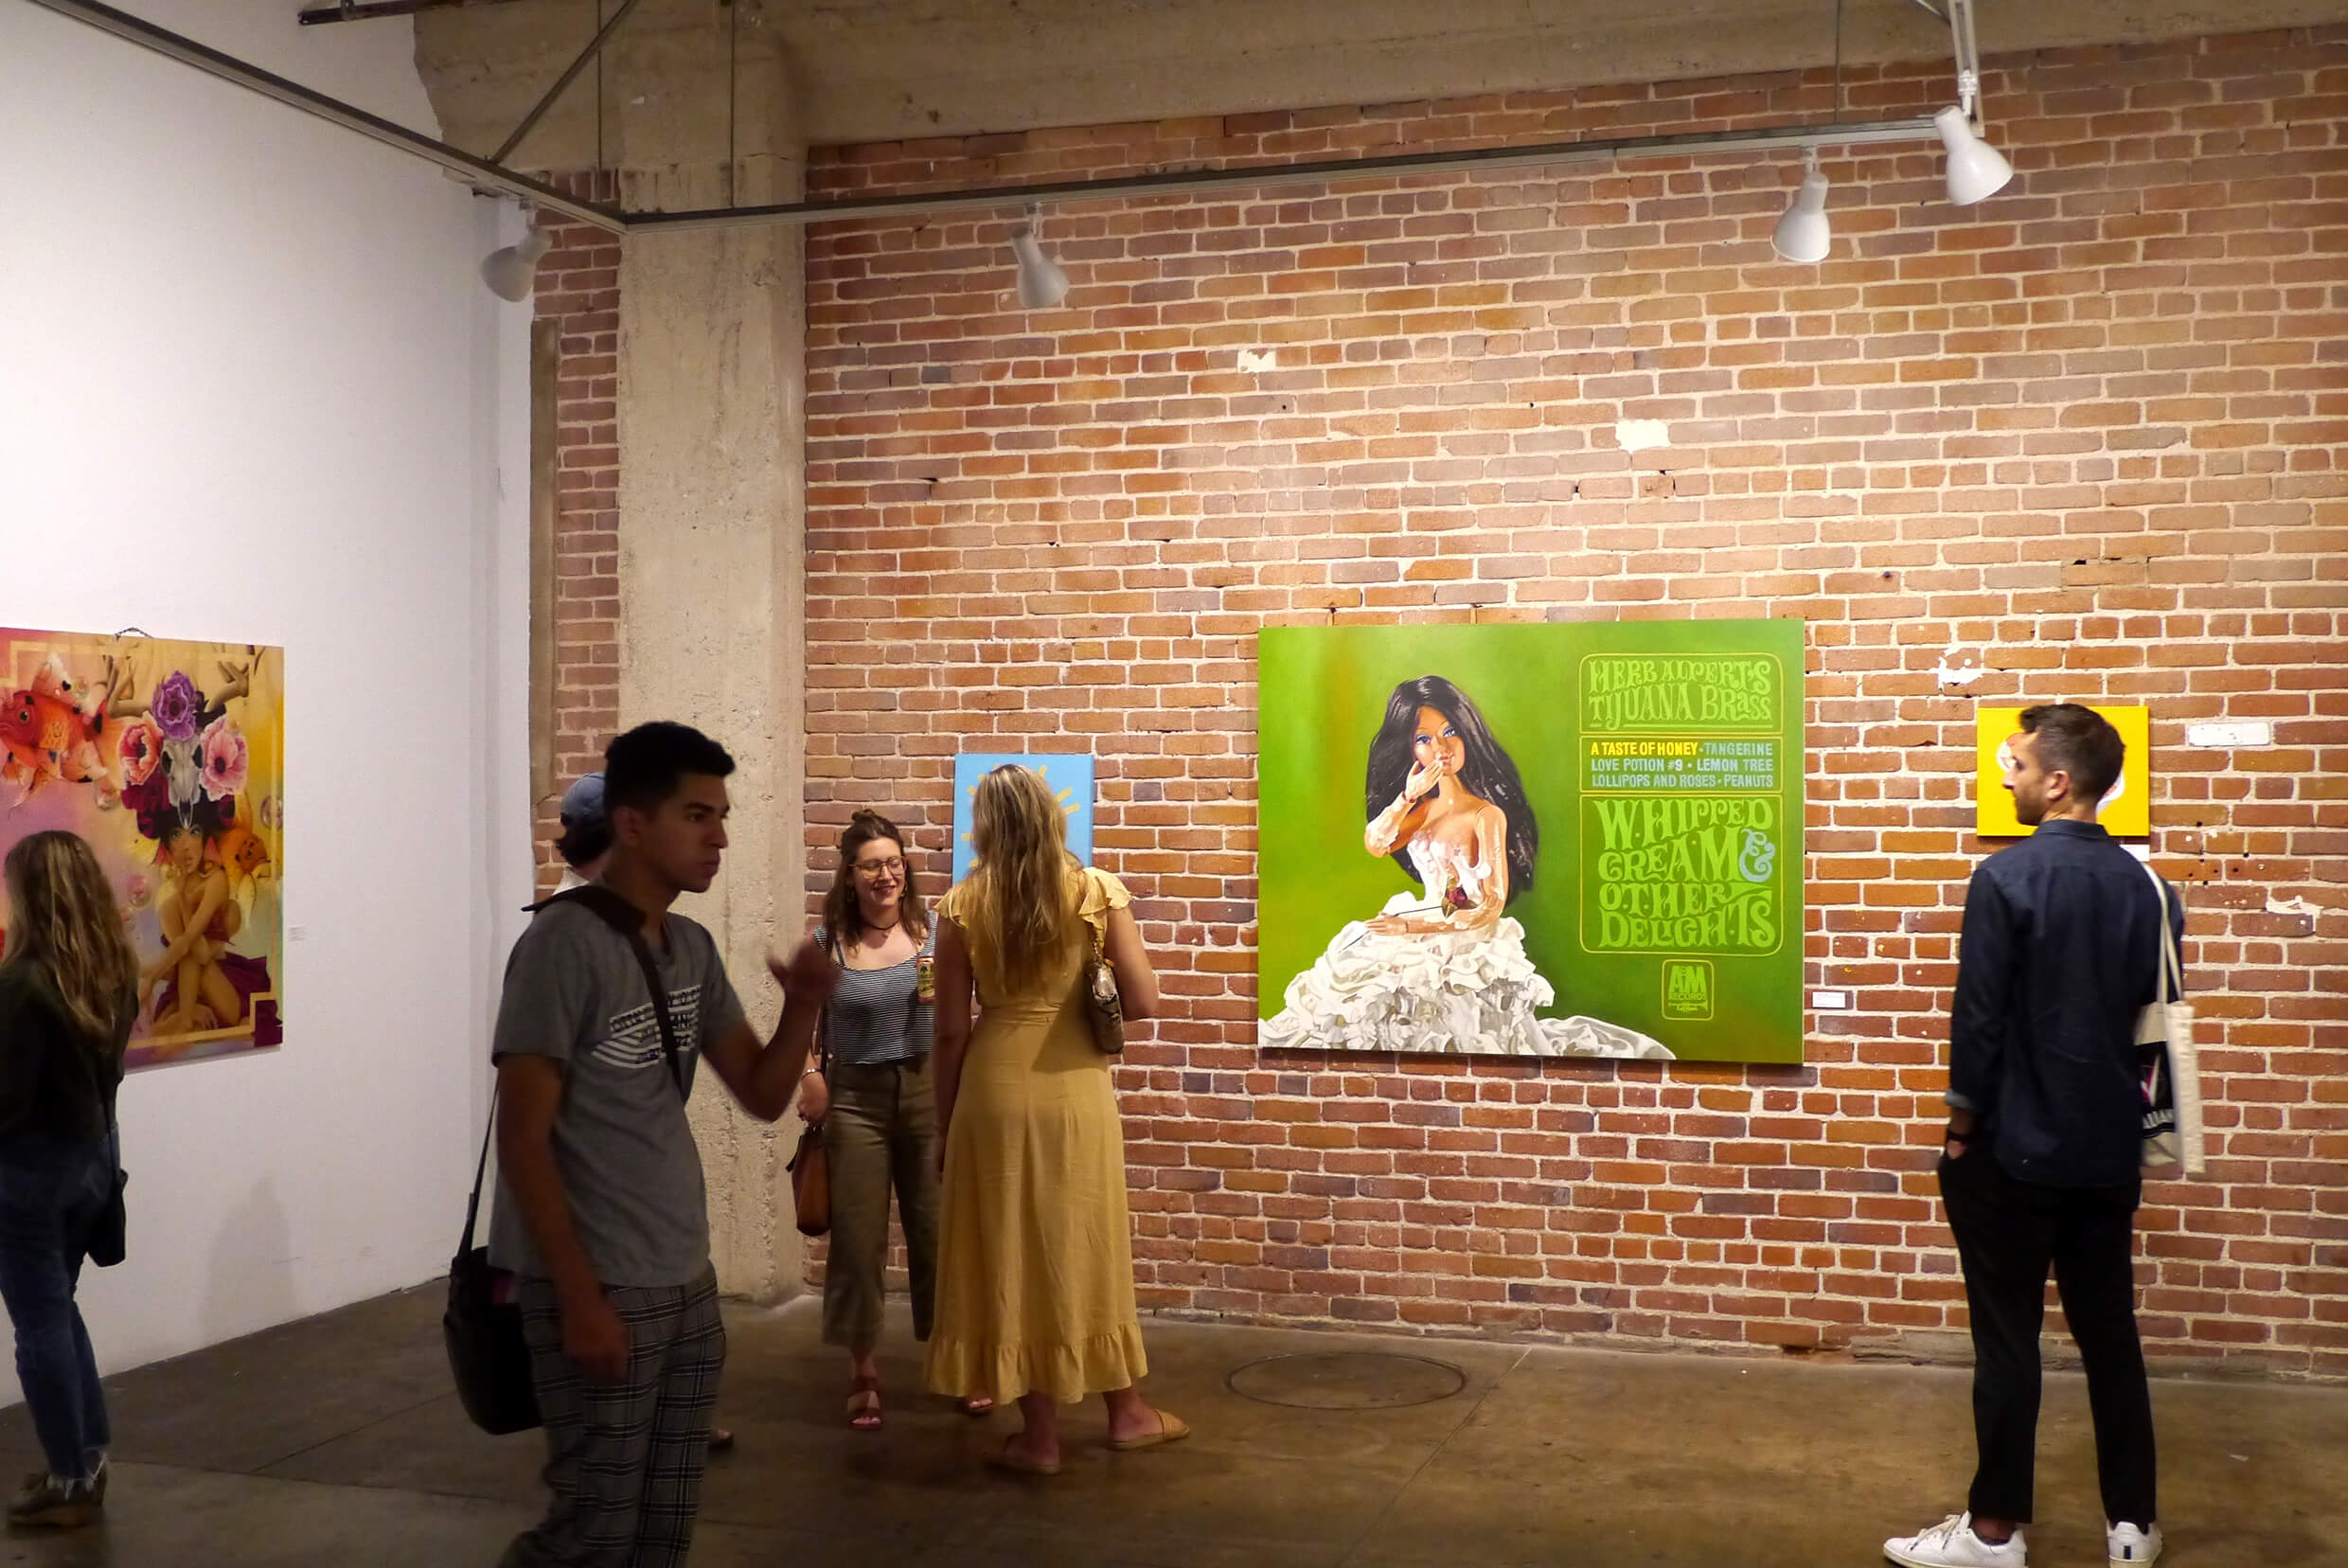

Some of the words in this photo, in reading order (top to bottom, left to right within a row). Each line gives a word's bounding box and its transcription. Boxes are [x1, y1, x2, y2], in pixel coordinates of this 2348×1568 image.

[1589, 660, 1658, 693] HERB
[1589, 684, 1696, 730] TIJUANA
[1591, 742, 1599, 756] A
[1601, 742, 1637, 756] TASTE
[1639, 742, 1656, 756] OF
[1658, 742, 1699, 756] HONEY
[1705, 742, 1772, 756] TANGERINE
[1591, 758, 1619, 772] LOVE
[1623, 758, 1664, 772] POTION
[1667, 758, 1683, 772] #9
[1697, 758, 1738, 772] LEMON
[1743, 758, 1773, 772] TREE
[1592, 775, 1649, 788] LOLLIPOPS
[1653, 775, 1677, 788] AND
[1680, 775, 1717, 788] ROSES
[1724, 775, 1773, 788] PEANUTS
[1593, 798, 1773, 850] WHIPPED
[1598, 826, 1742, 882] CREAM
[1739, 829, 1776, 882] &
[1598, 882, 1771, 918] OTHER
[1598, 890, 1776, 948] DELIGHTS
